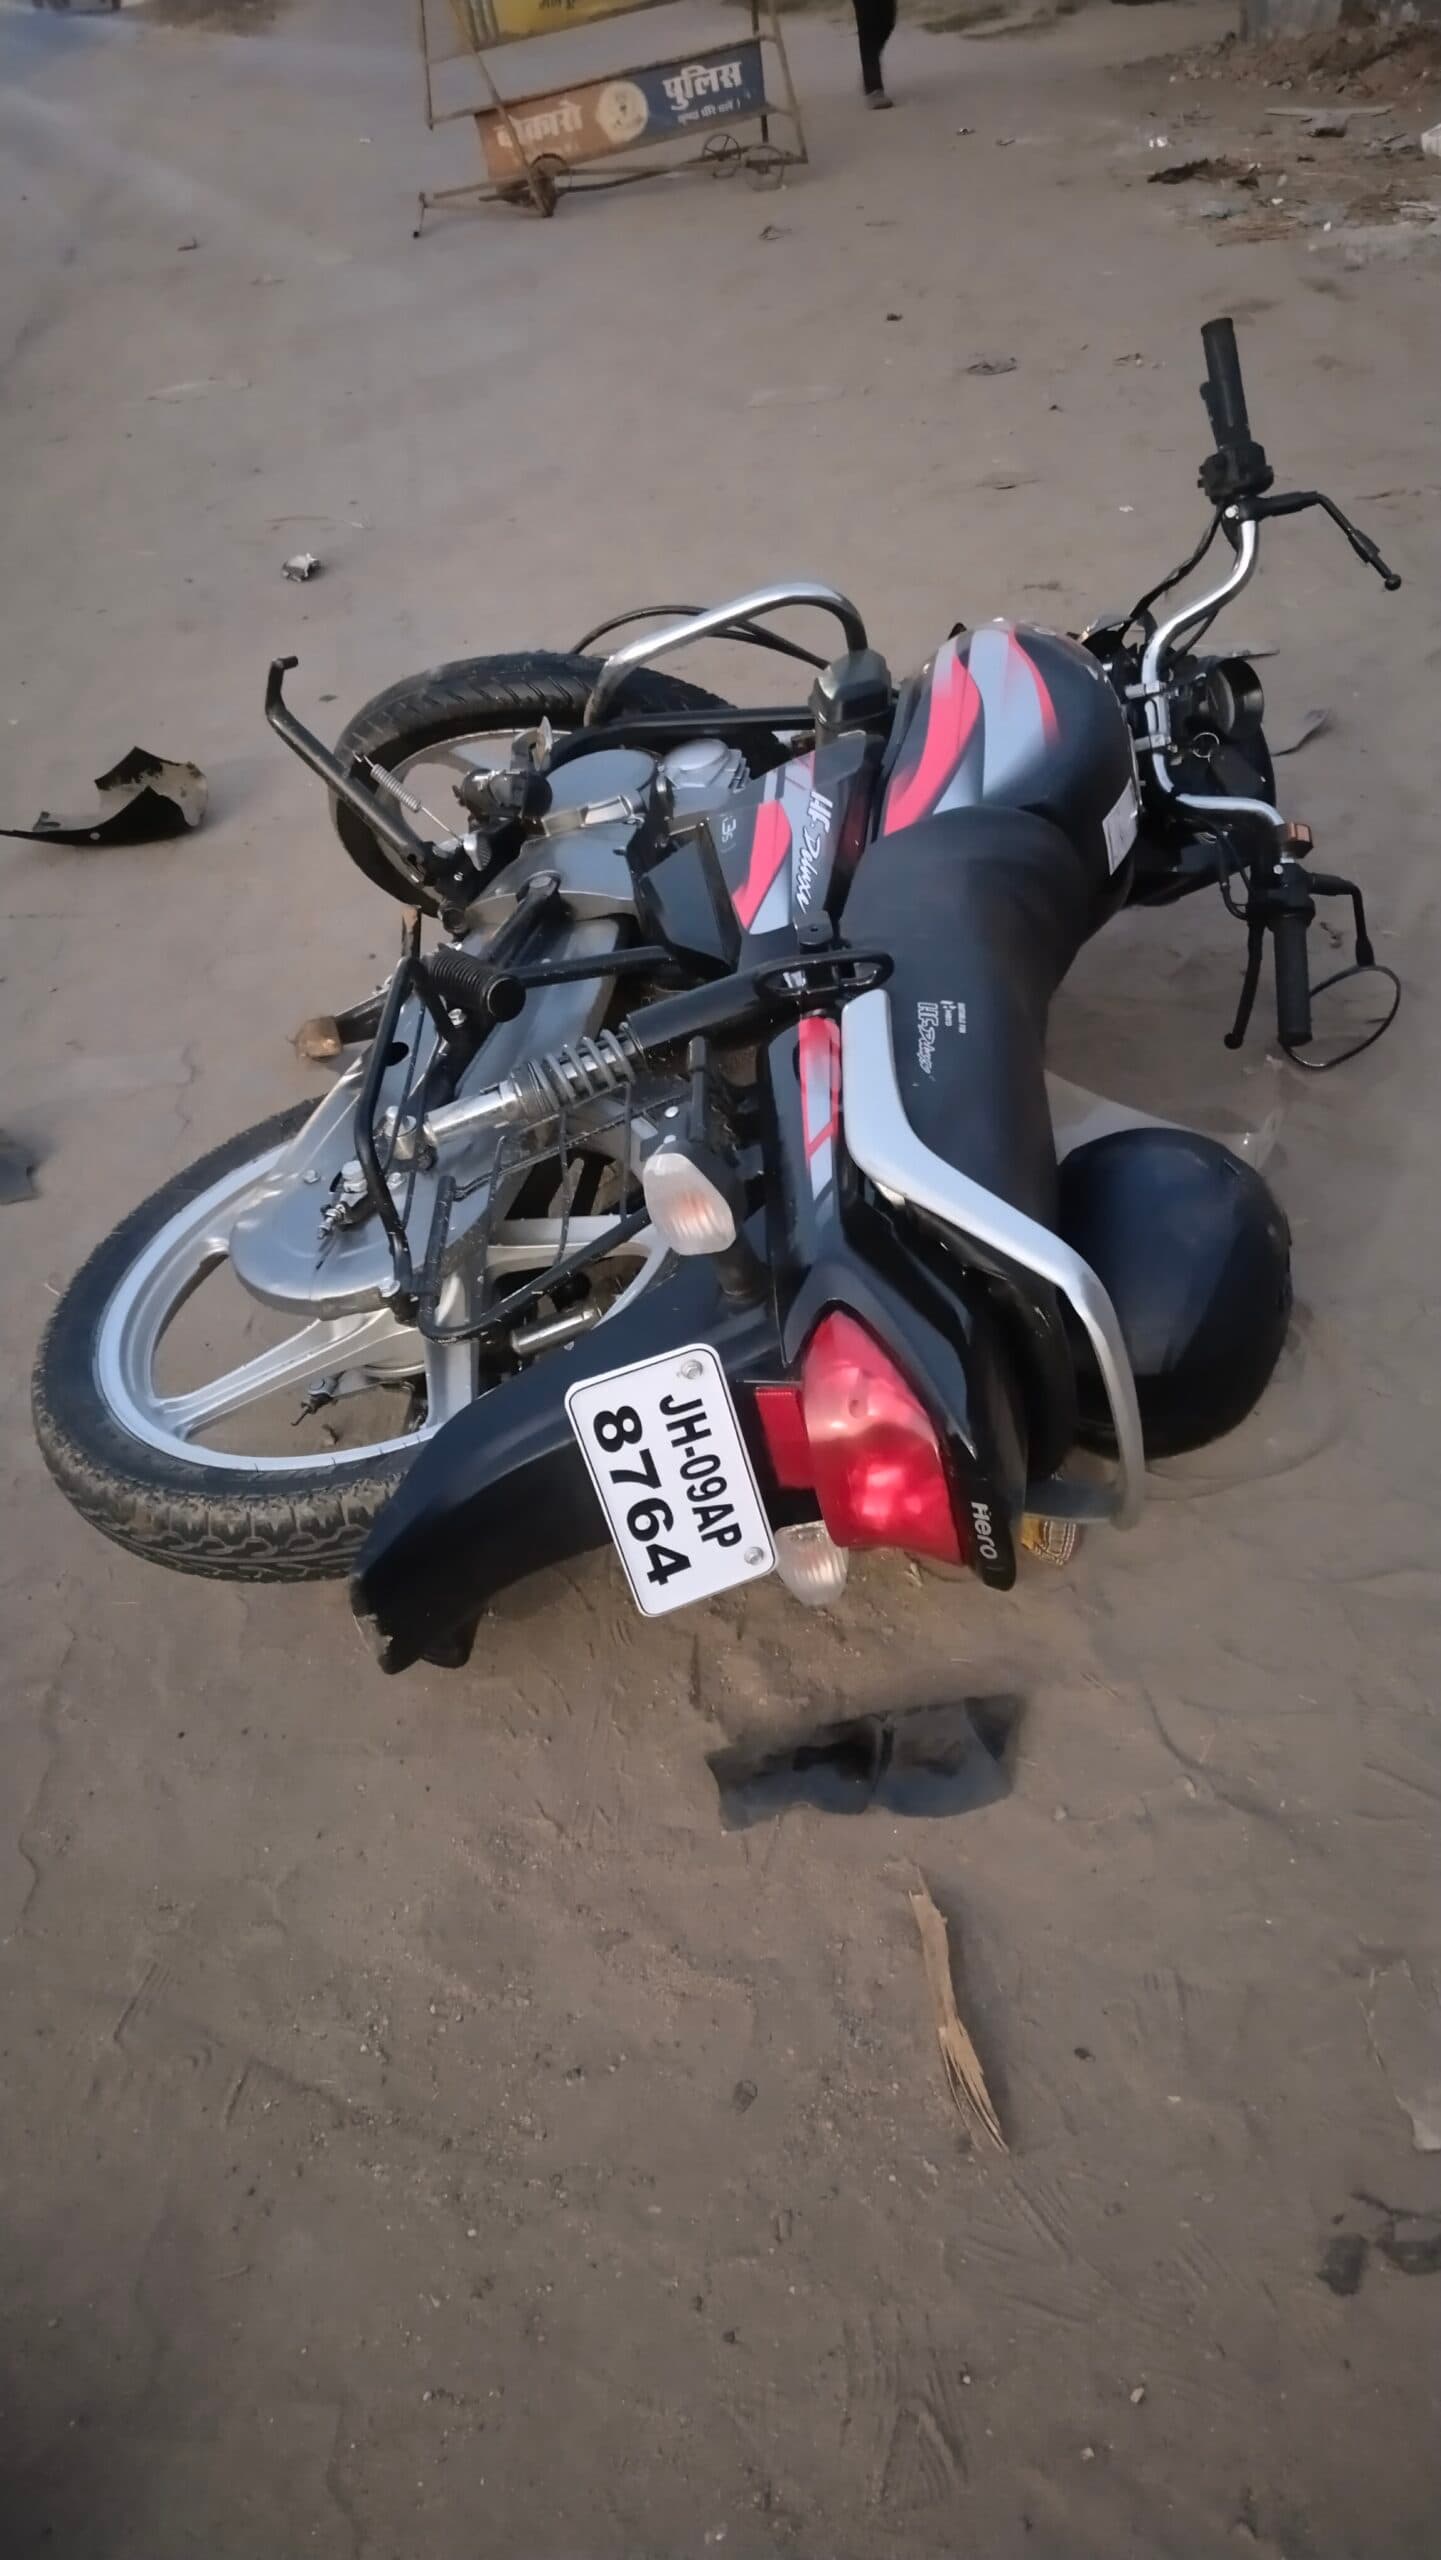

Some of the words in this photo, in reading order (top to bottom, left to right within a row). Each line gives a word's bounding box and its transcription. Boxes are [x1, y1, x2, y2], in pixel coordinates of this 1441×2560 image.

[662, 61, 743, 111] पुलिस
[593, 1405, 692, 1586] 8764
[659, 1394, 743, 1549] JH-09AP
[969, 1501, 1000, 1561] Hero
